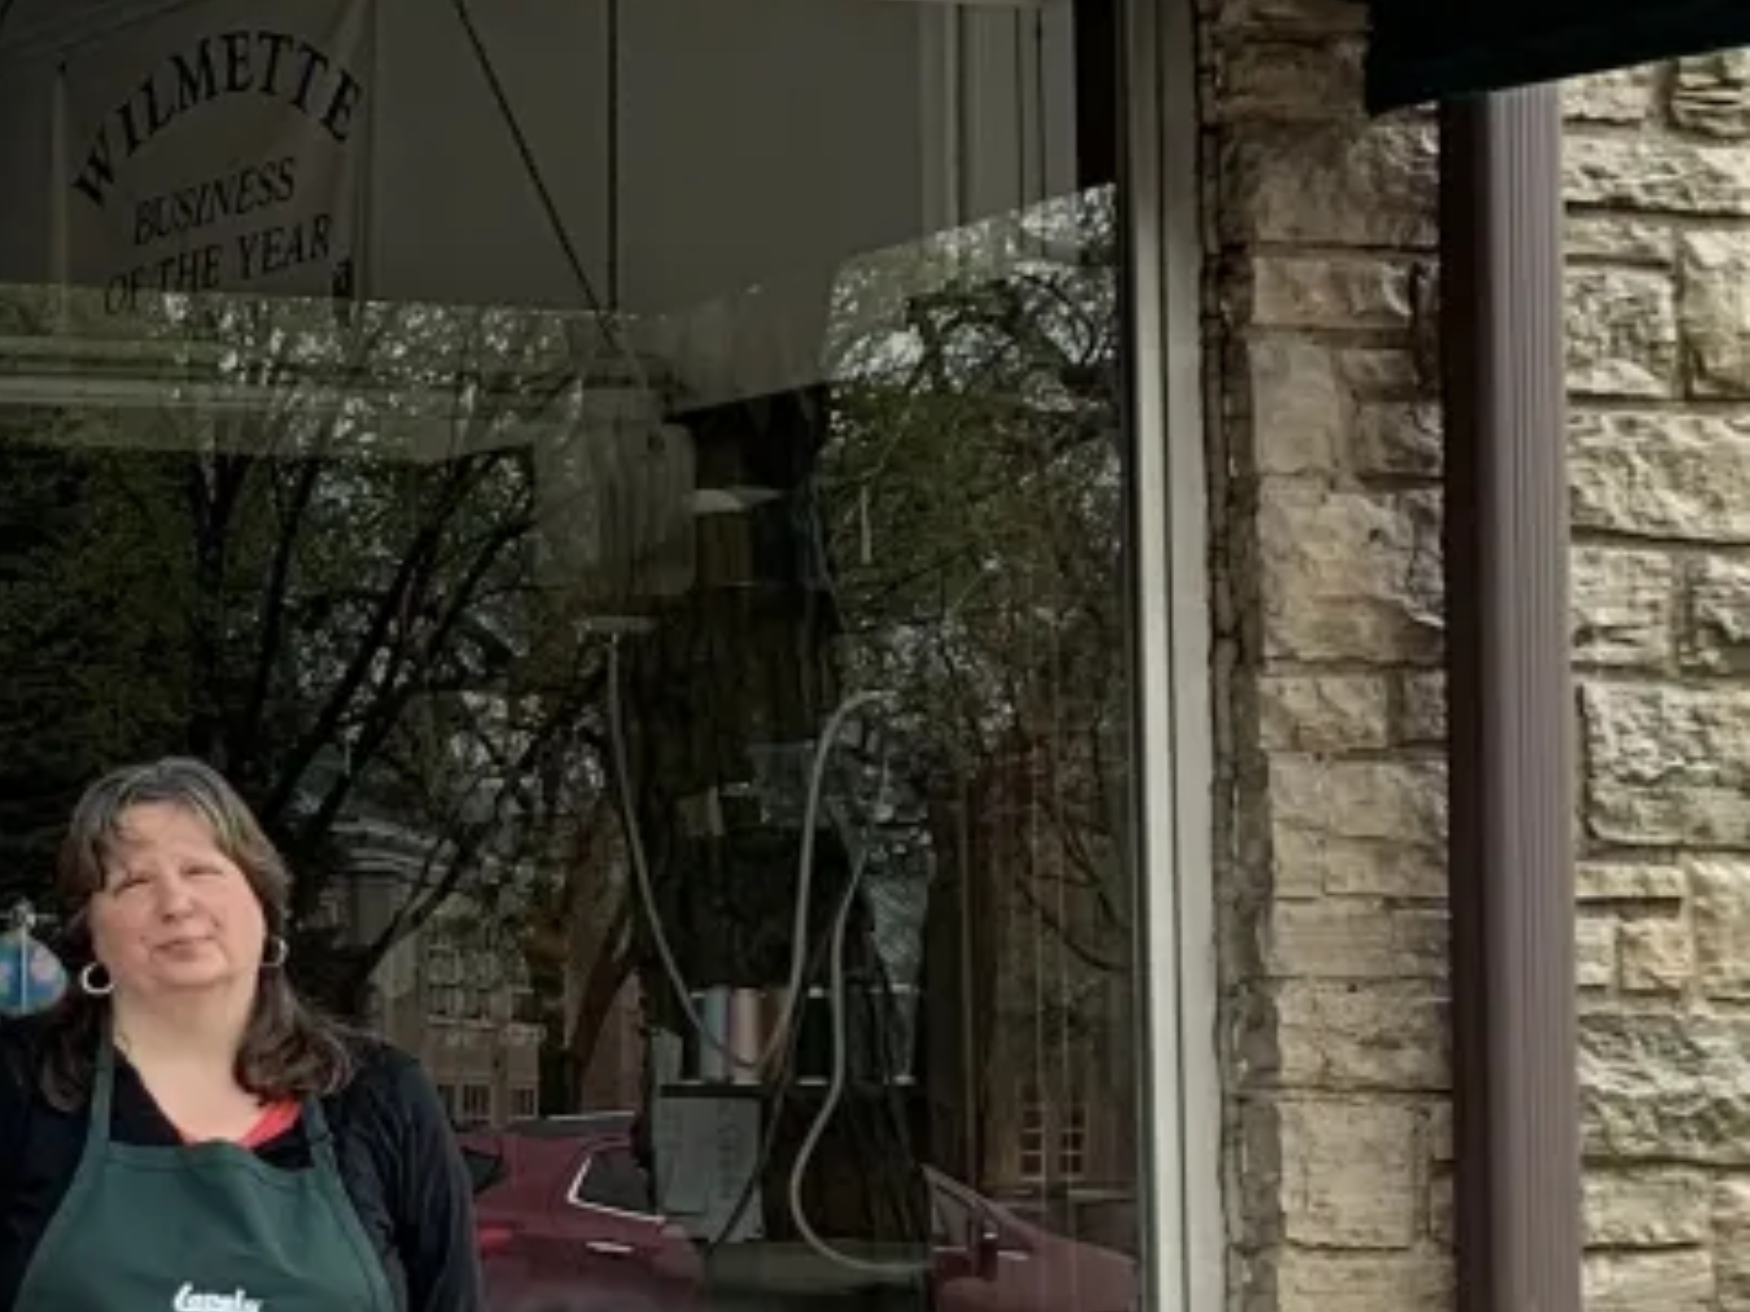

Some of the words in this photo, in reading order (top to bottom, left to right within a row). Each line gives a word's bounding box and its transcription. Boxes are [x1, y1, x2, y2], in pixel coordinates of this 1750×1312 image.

[72, 31, 362, 208] WILMETTE
[133, 157, 296, 245] BUSINESS
[105, 266, 148, 315] OF
[158, 245, 224, 294] THE
[238, 212, 333, 280] YEAR
